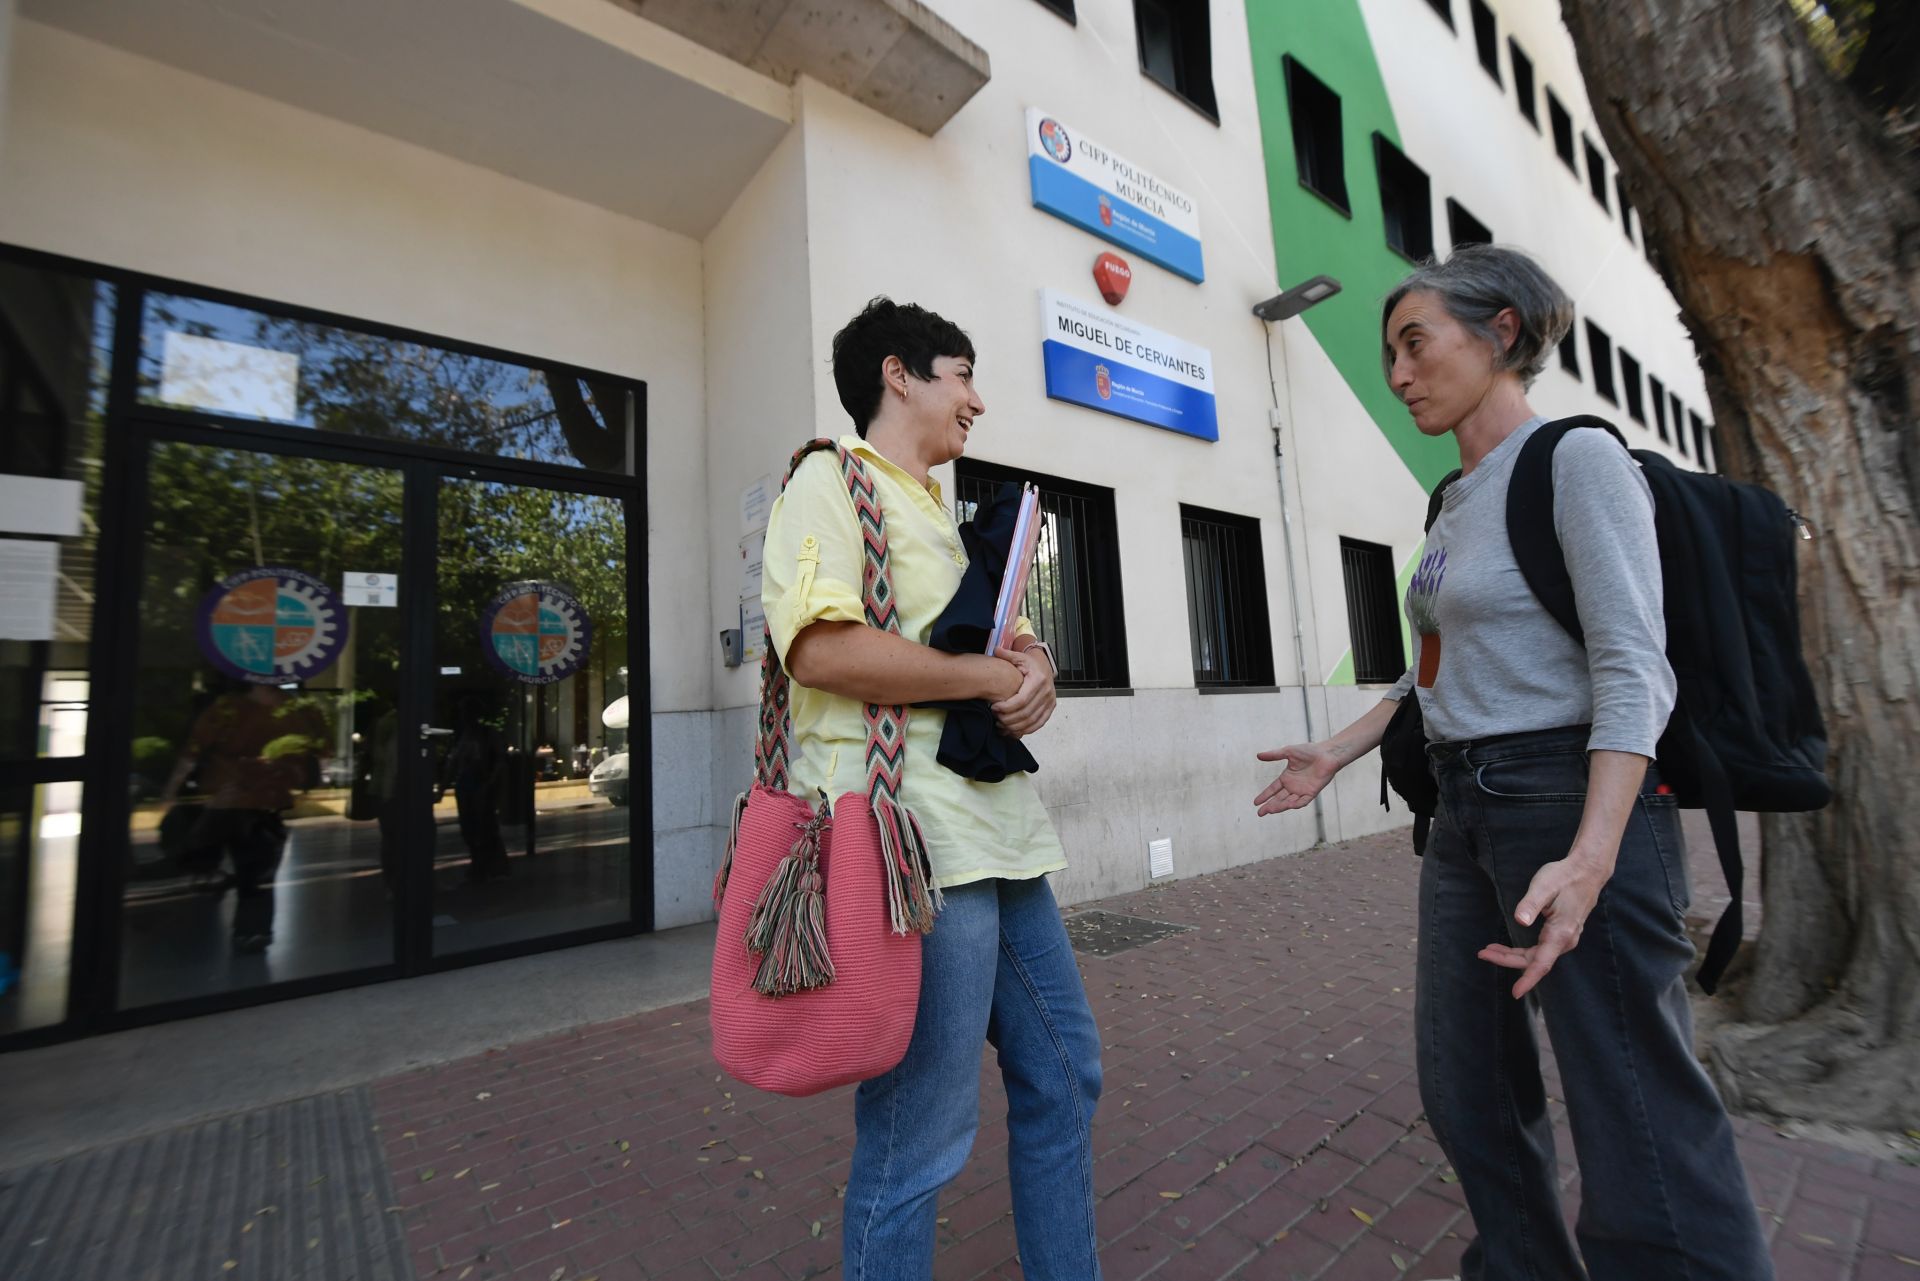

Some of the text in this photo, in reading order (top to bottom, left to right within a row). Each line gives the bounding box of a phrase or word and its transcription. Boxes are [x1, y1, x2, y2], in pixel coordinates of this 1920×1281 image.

[1079, 140, 1192, 214] CIFP POLITÉCNICO
[1116, 180, 1166, 218] MURCIA
[1104, 261, 1130, 278] FUEGO
[1058, 315, 1206, 380] MIGUEL DE CERVANTES
[517, 674, 560, 684] MURCIA
